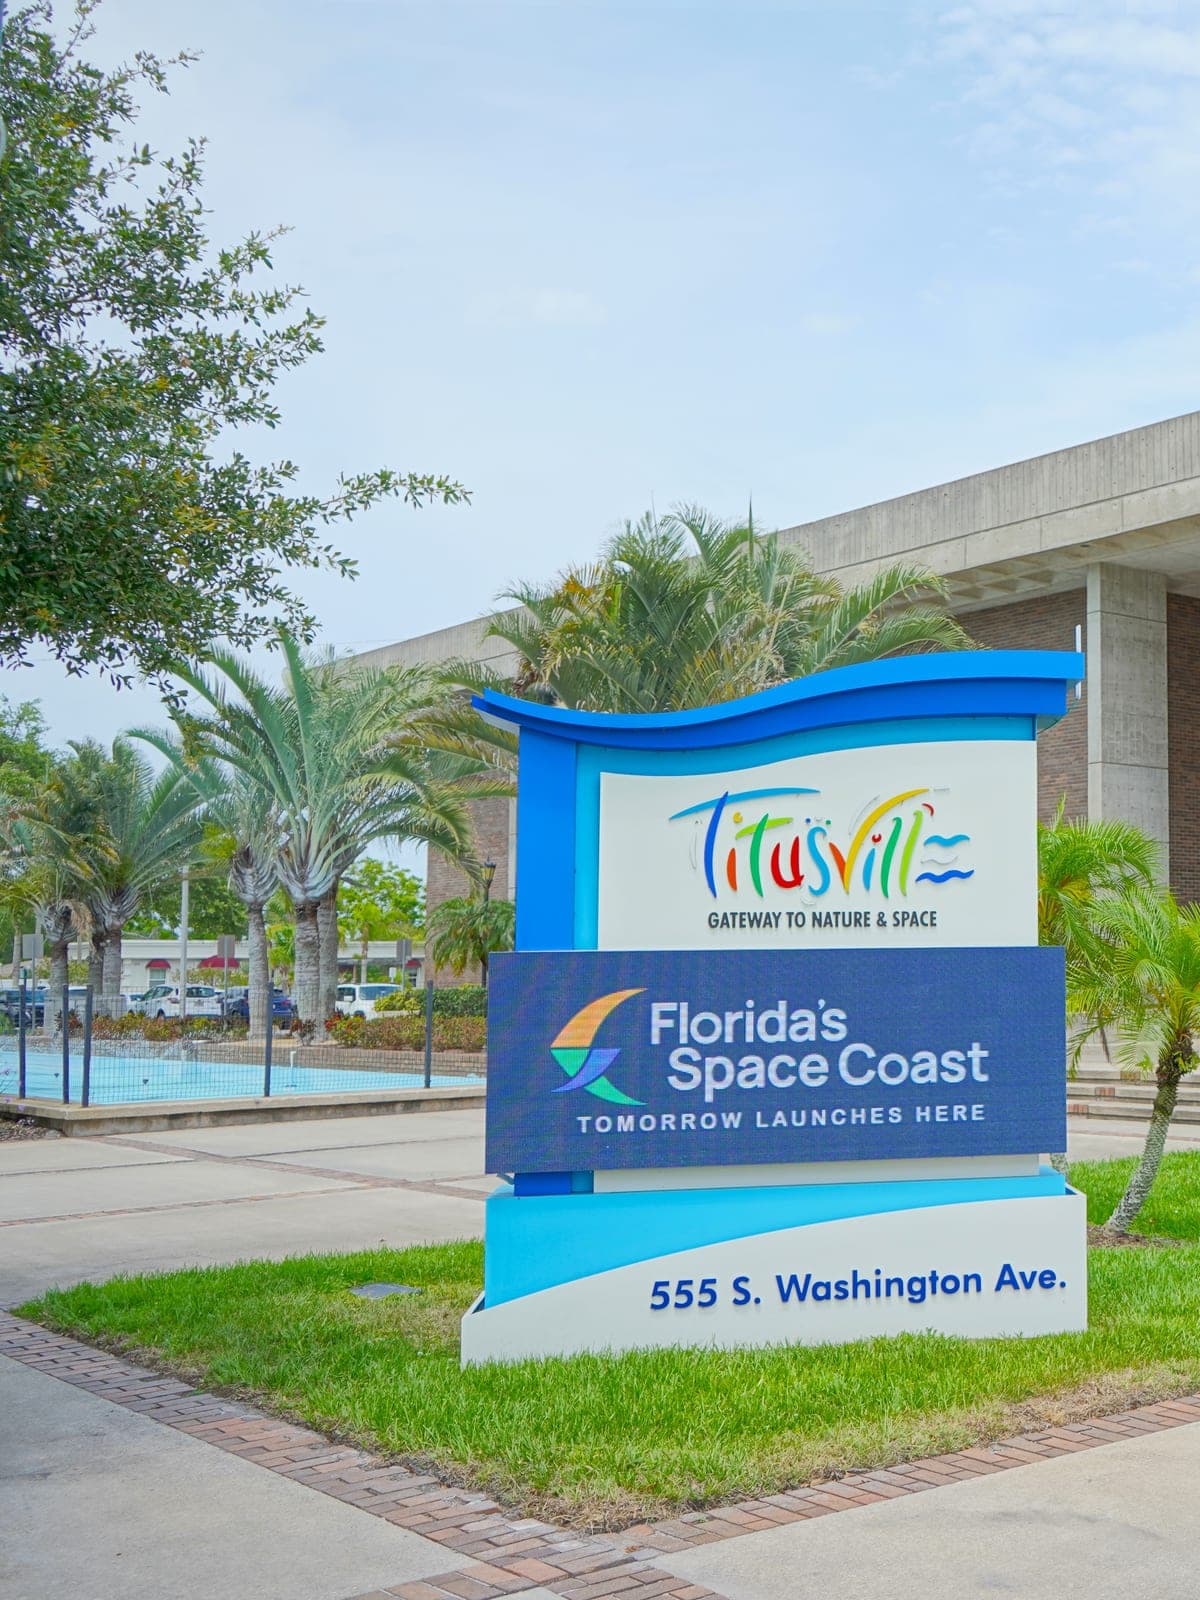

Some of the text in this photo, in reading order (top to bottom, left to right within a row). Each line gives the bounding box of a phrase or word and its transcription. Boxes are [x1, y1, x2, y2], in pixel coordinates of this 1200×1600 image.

[708, 910, 937, 928] GATEWAY TO NATURE & SPACE
[650, 999, 848, 1045] Florida's
[667, 1042, 989, 1103] Space Coast
[577, 1104, 986, 1134] TOMORROW LAUNCHES HERE
[650, 1263, 1067, 1310] 555 S. Washington Ave.
